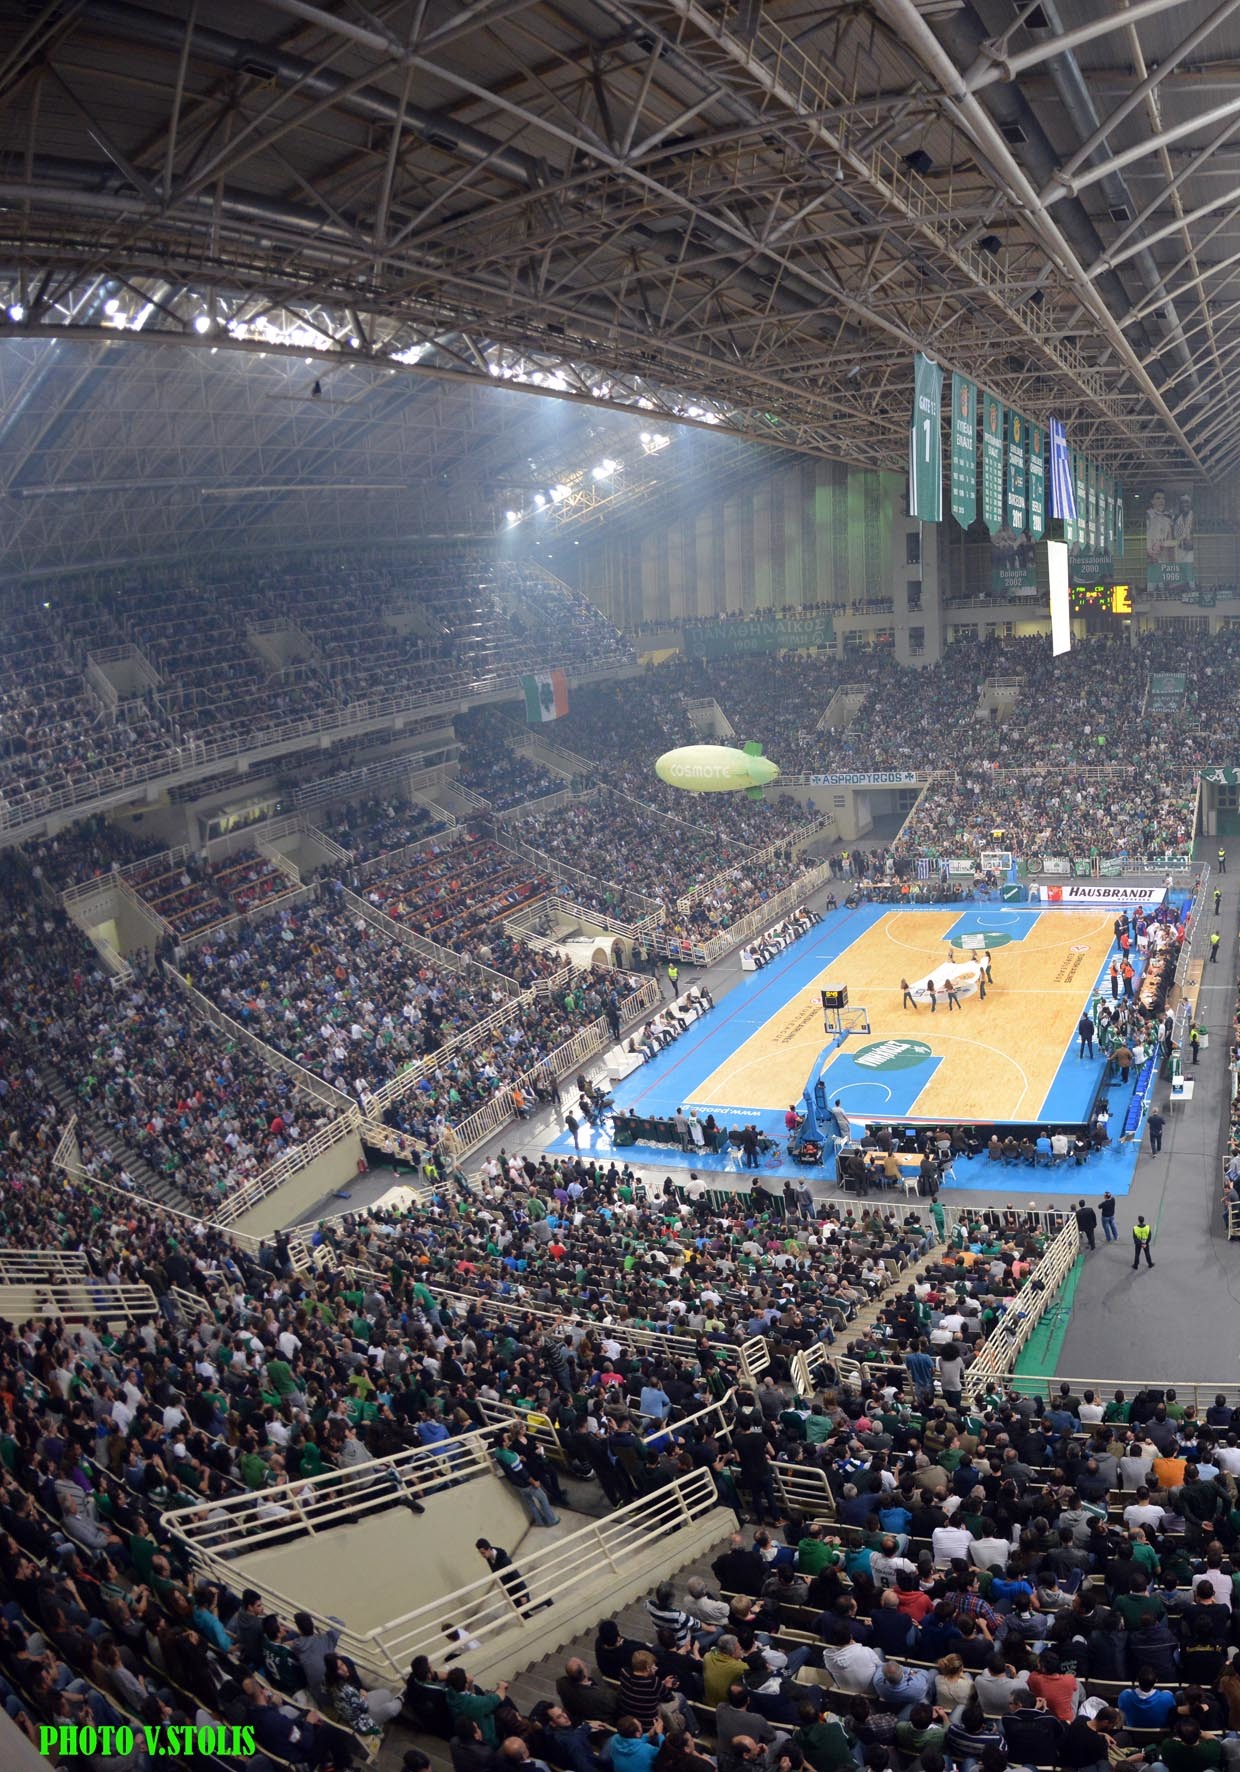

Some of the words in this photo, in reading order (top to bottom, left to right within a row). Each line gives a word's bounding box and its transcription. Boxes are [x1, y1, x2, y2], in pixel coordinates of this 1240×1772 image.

[1161, 564, 1180, 572] Paris
[1000, 569, 1027, 579] Bologna
[1005, 578, 1022, 586] 2002
[670, 763, 731, 779] COSMOTE
[822, 773, 902, 785] ASPROPYRGOS
[1069, 886, 1155, 898] HAUSBRANDT
